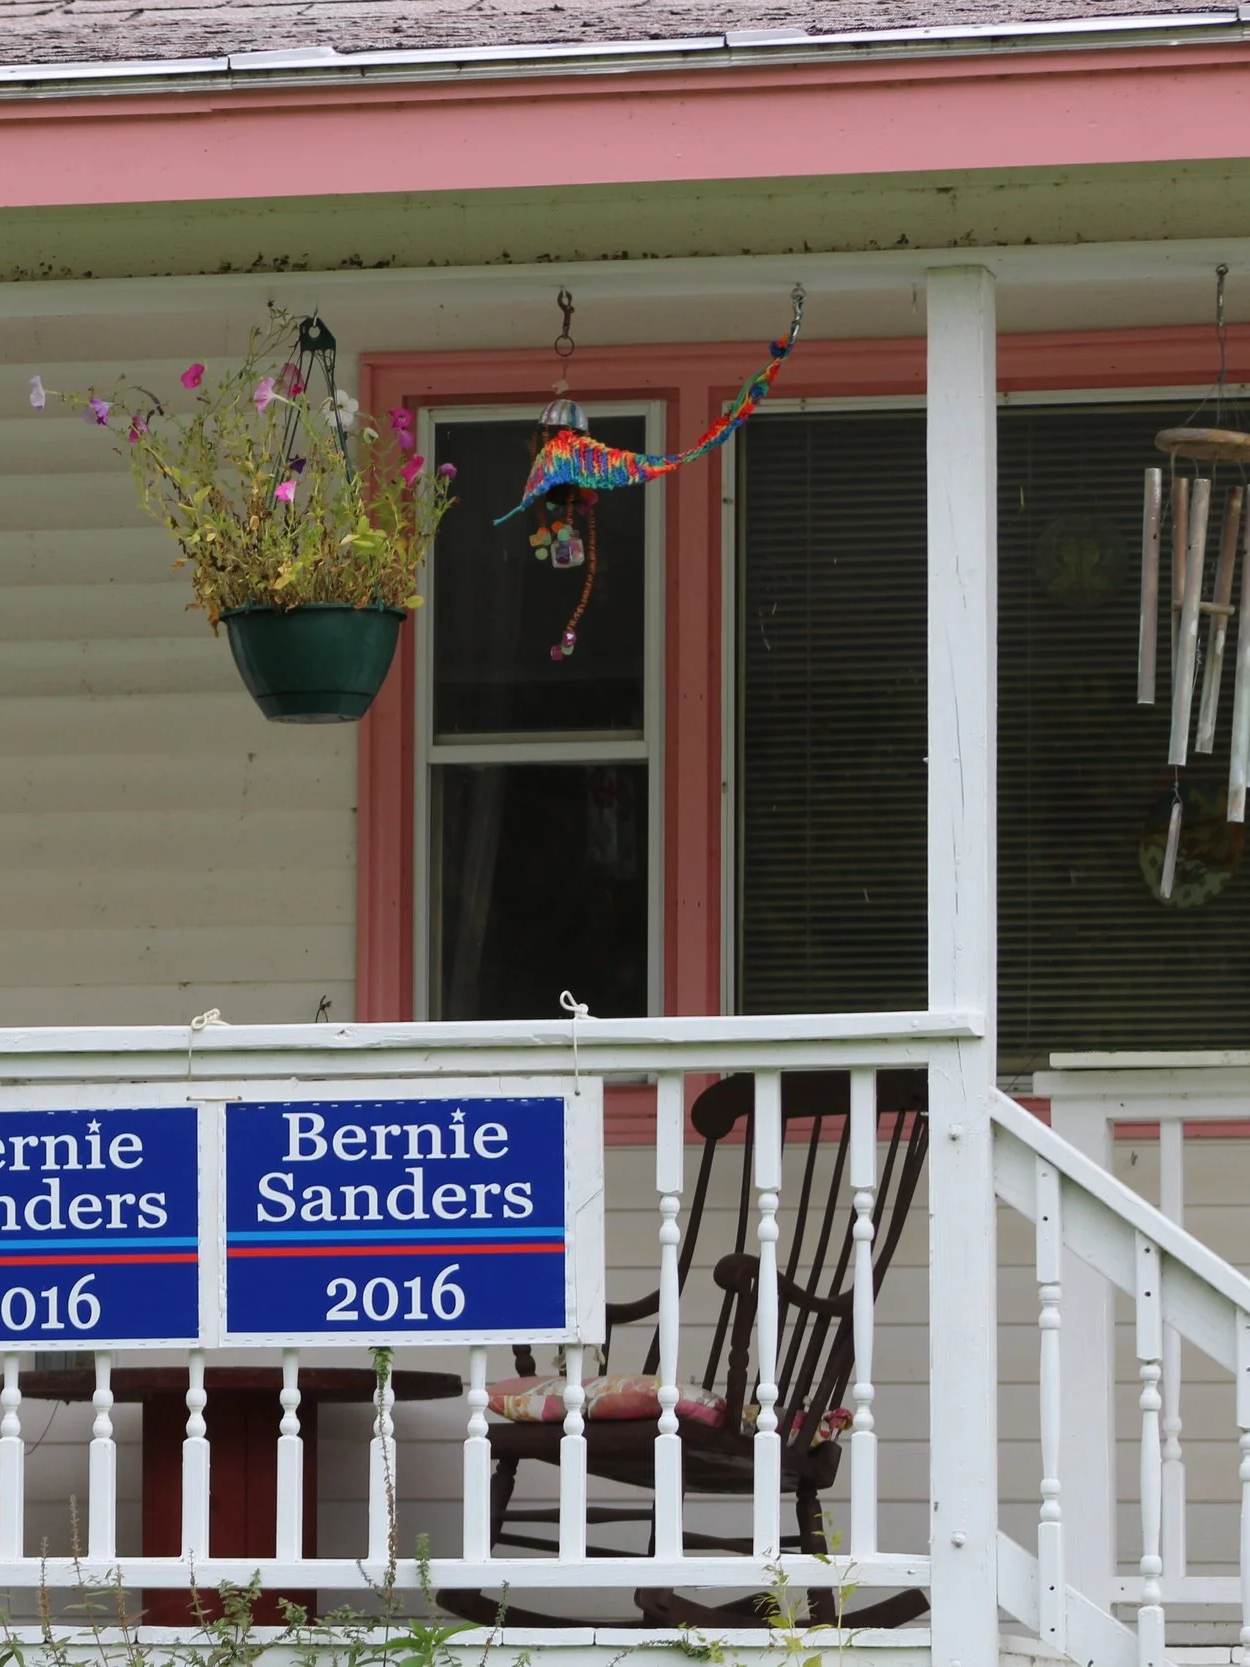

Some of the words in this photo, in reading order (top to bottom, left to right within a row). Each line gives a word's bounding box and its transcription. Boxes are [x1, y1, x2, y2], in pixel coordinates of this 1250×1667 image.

[282, 1108, 509, 1162] Bernie
[258, 1167, 534, 1223] Sanders
[326, 1264, 466, 1322] 2016
